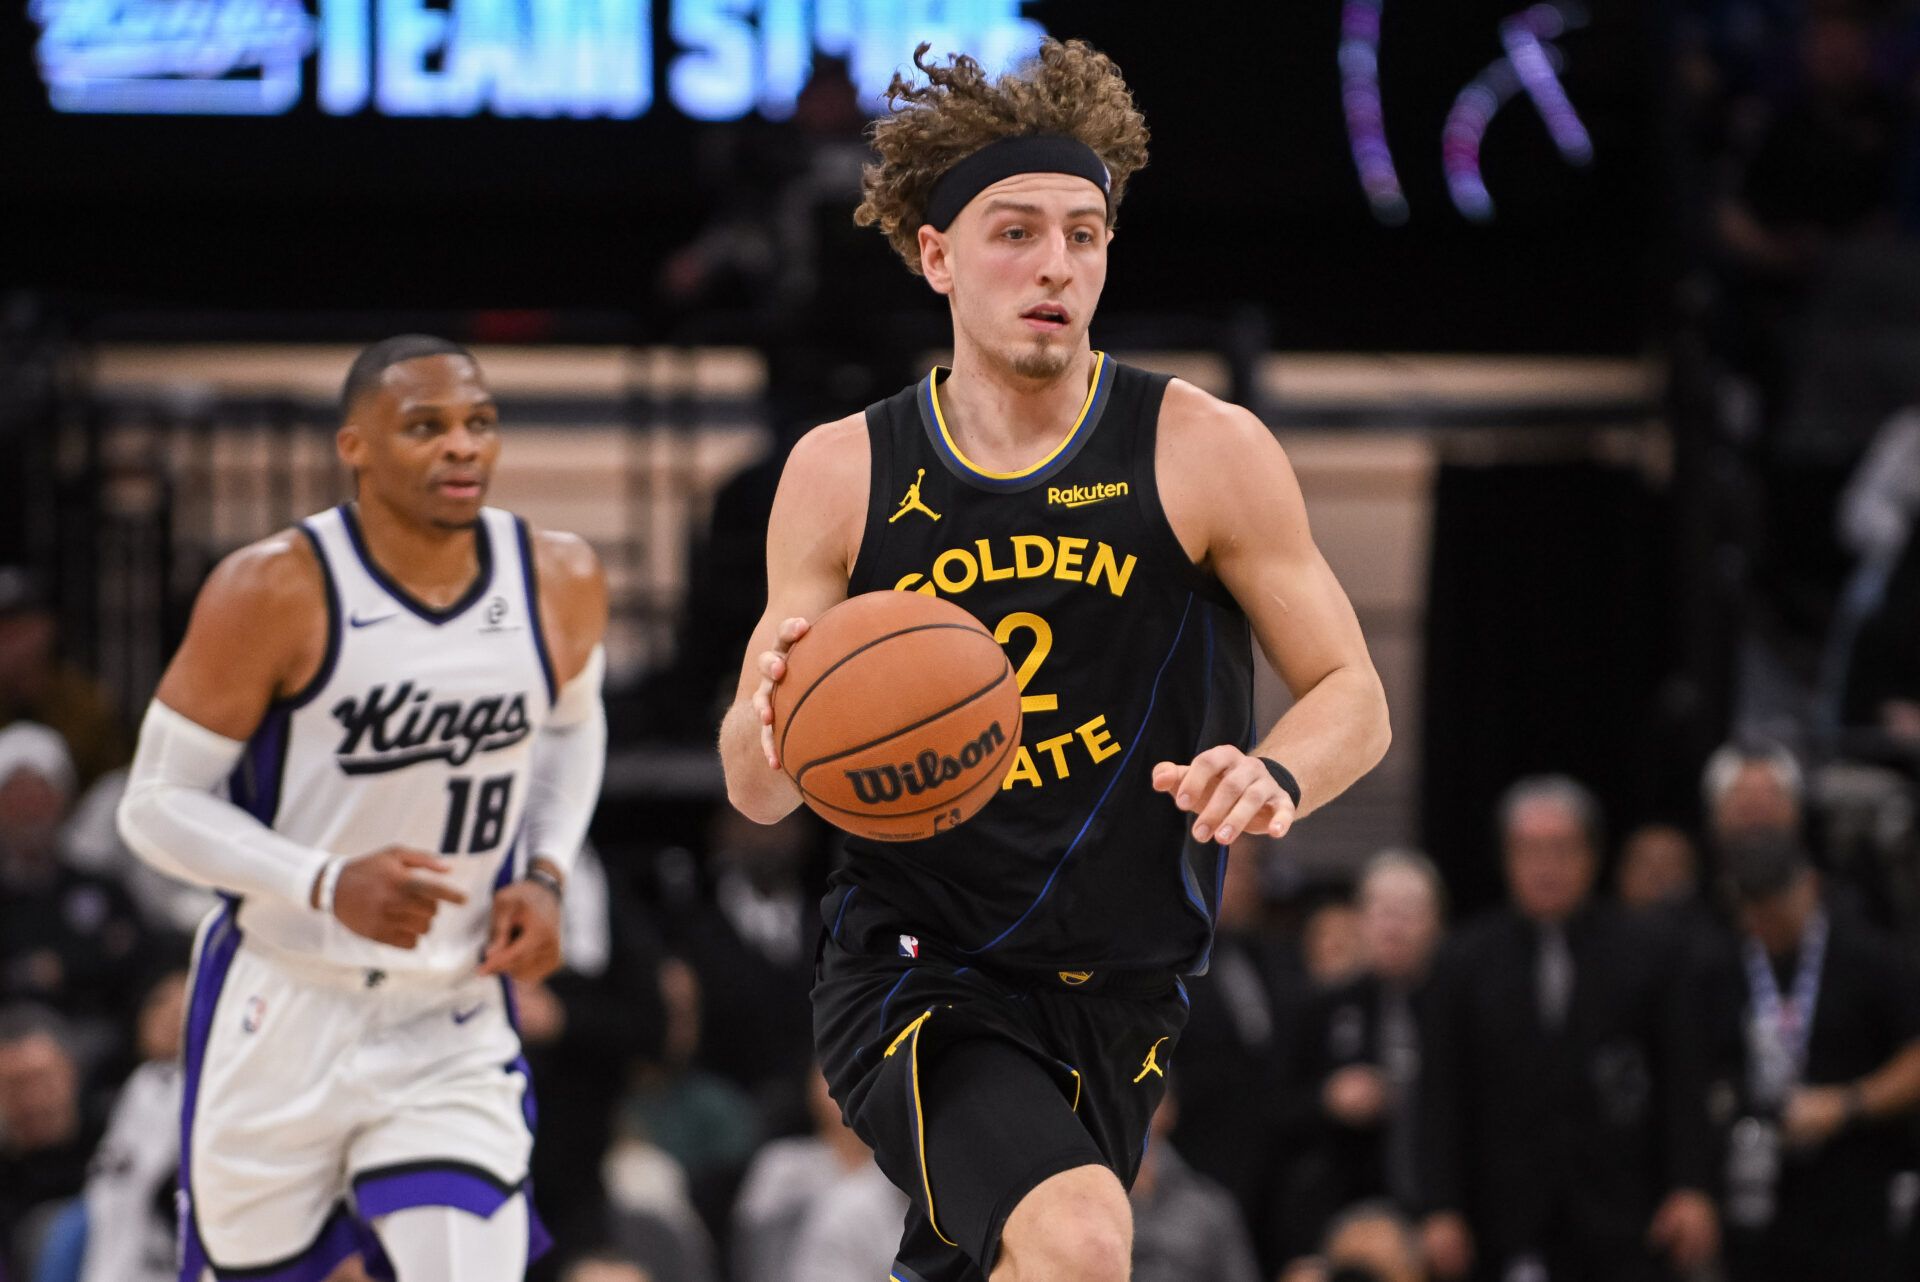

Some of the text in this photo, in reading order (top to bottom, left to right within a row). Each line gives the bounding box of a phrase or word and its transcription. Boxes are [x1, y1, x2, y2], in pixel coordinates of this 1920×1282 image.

[1047, 481, 1129, 507] Rakuten
[994, 611, 1058, 713] 2
[331, 680, 530, 775] Kings
[844, 720, 1006, 805] Wilson
[1002, 714, 1122, 790] ATE
[440, 773, 515, 854] 18
